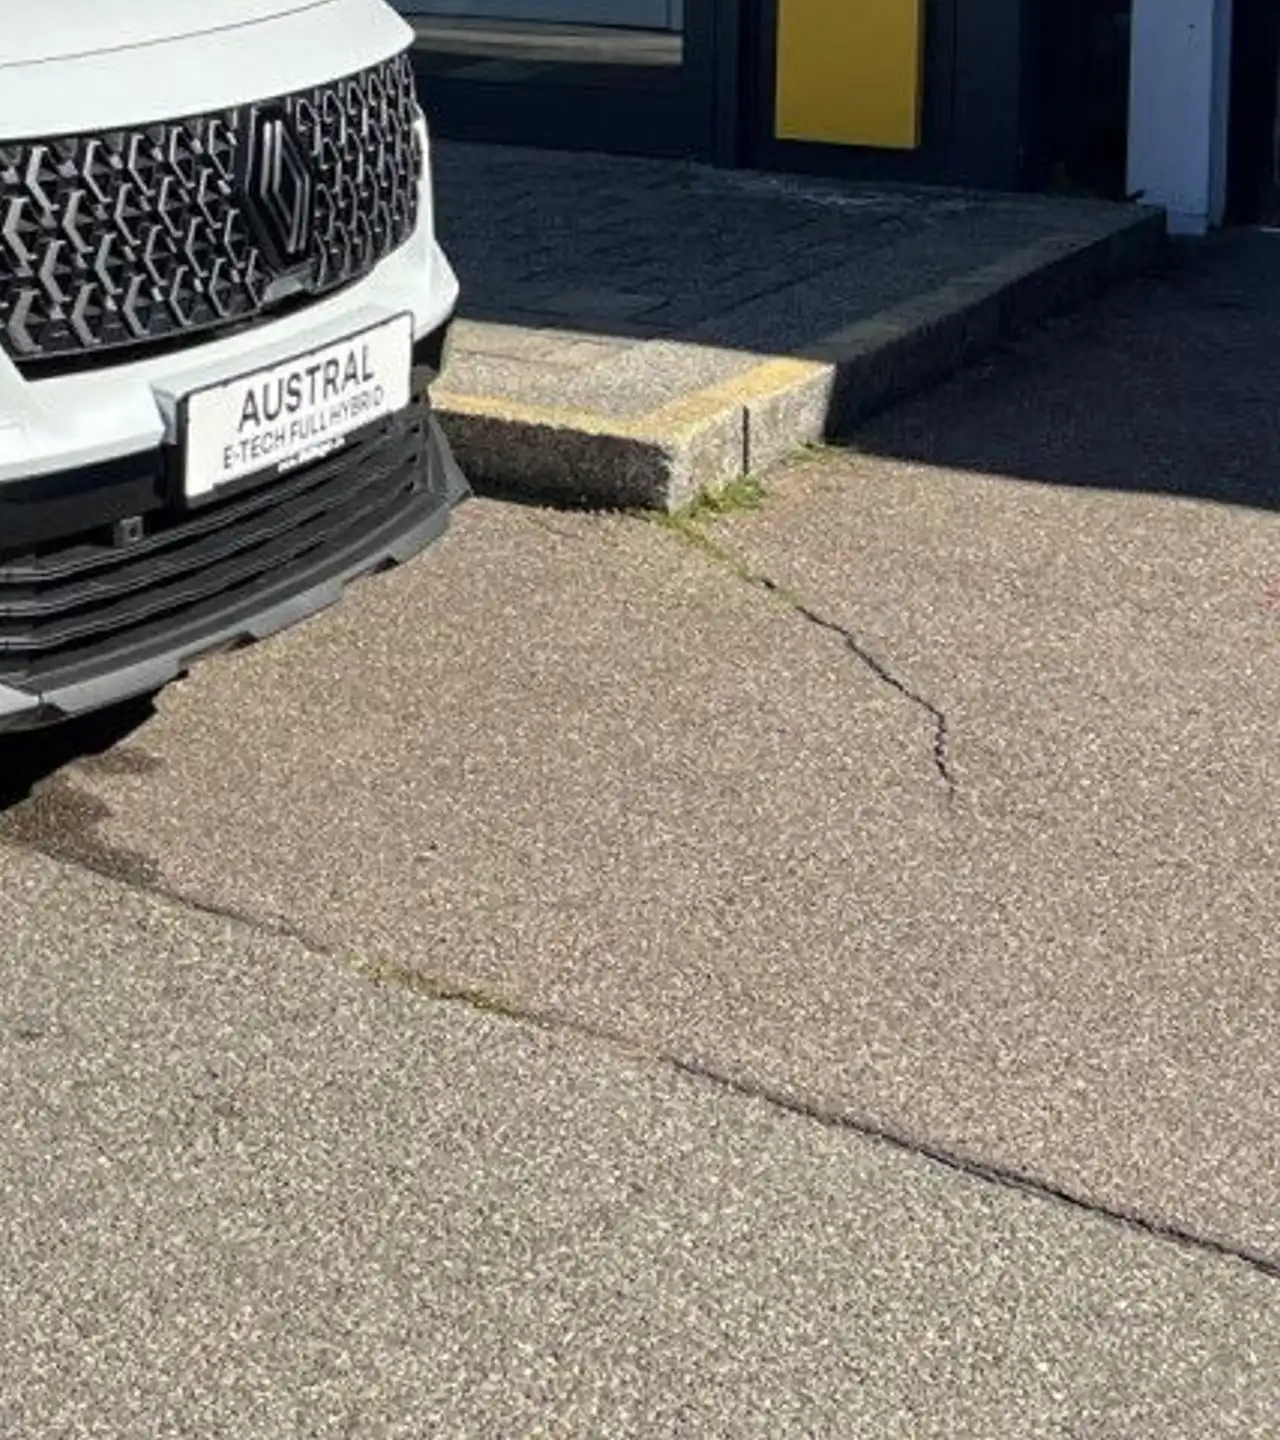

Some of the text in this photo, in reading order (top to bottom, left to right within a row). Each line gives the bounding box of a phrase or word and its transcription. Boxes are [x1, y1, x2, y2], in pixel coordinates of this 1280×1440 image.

[223, 424, 285, 470] E-TECH
[290, 409, 328, 444] FULL
[329, 384, 385, 427] HYBRID
[237, 344, 375, 433] AUSTRAL
